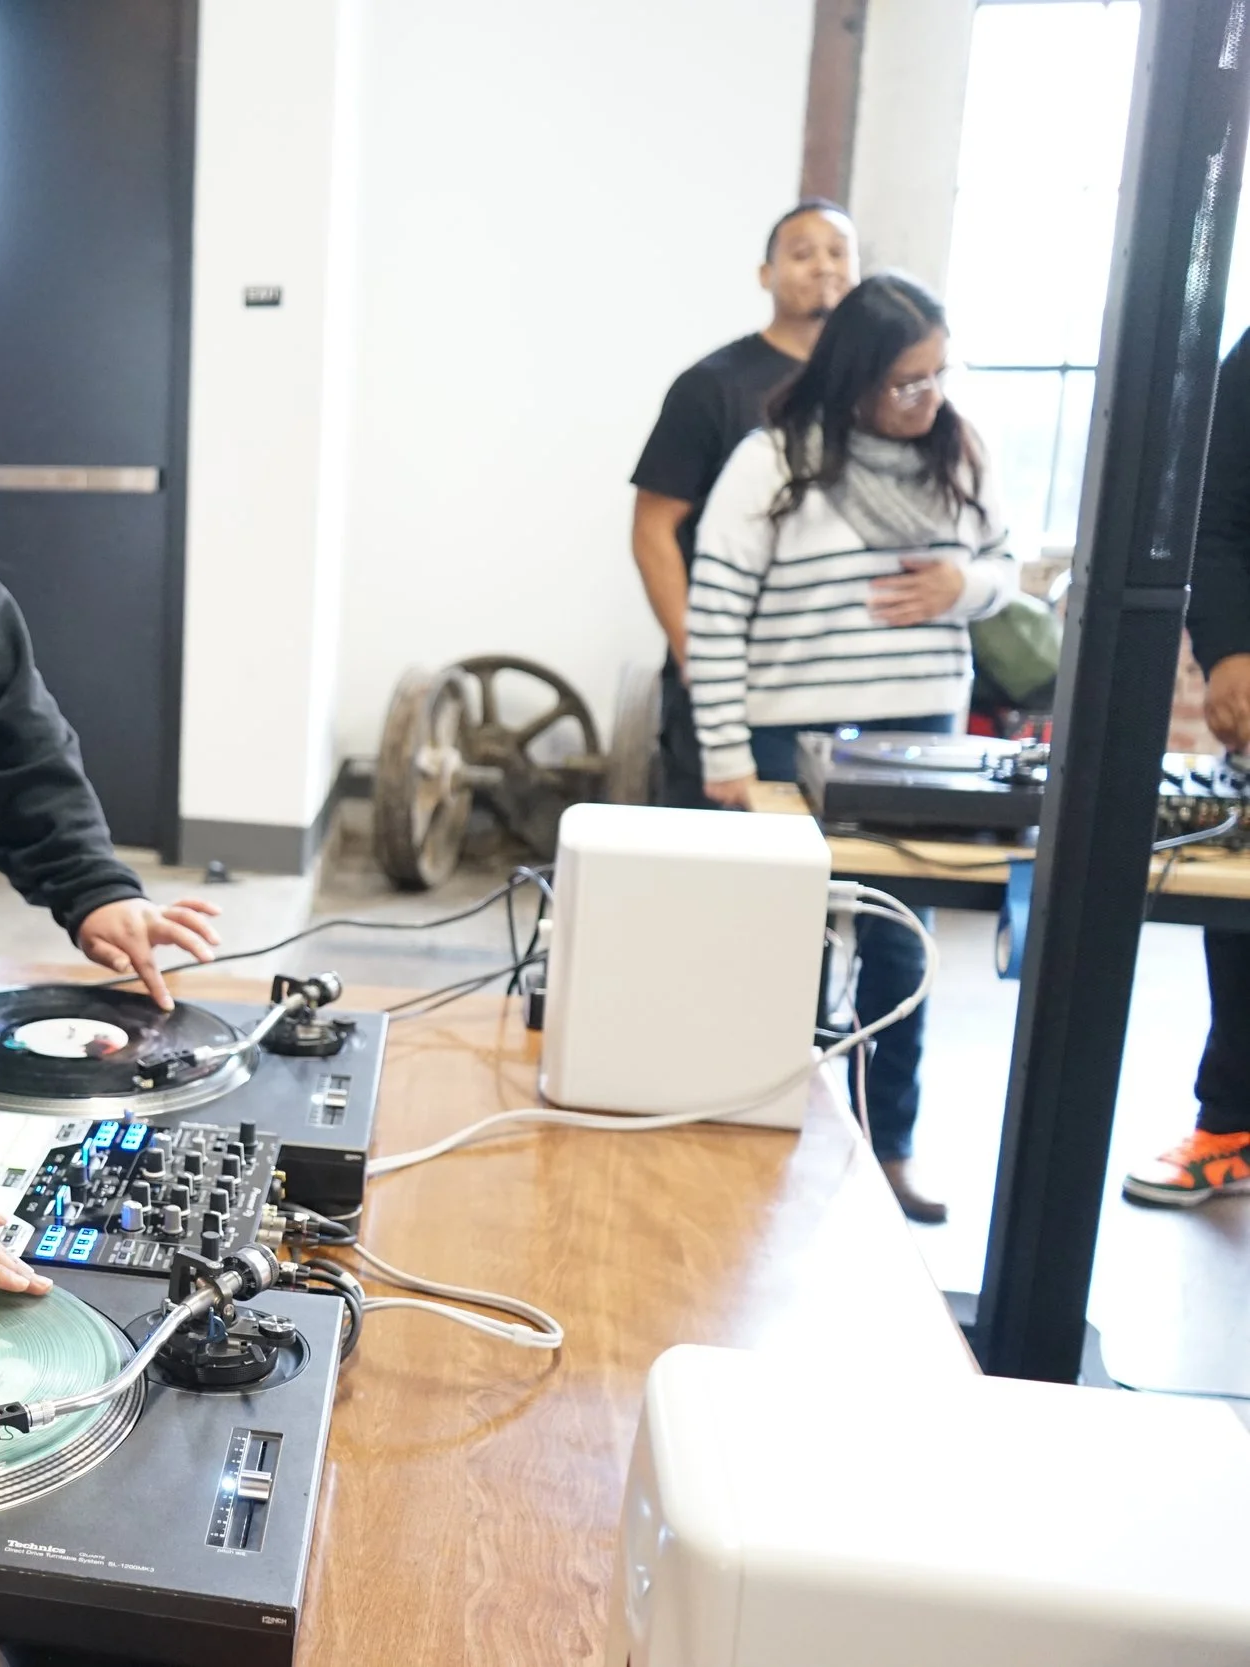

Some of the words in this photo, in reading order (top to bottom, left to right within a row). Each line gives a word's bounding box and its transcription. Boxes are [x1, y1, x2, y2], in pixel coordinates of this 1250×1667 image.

[7, 1539, 66, 1554] Technics
[4, 1546, 25, 1554] Direct
[25, 1549, 44, 1557] Drive
[45, 1552, 77, 1562] Turntable
[78, 1557, 105, 1566] System
